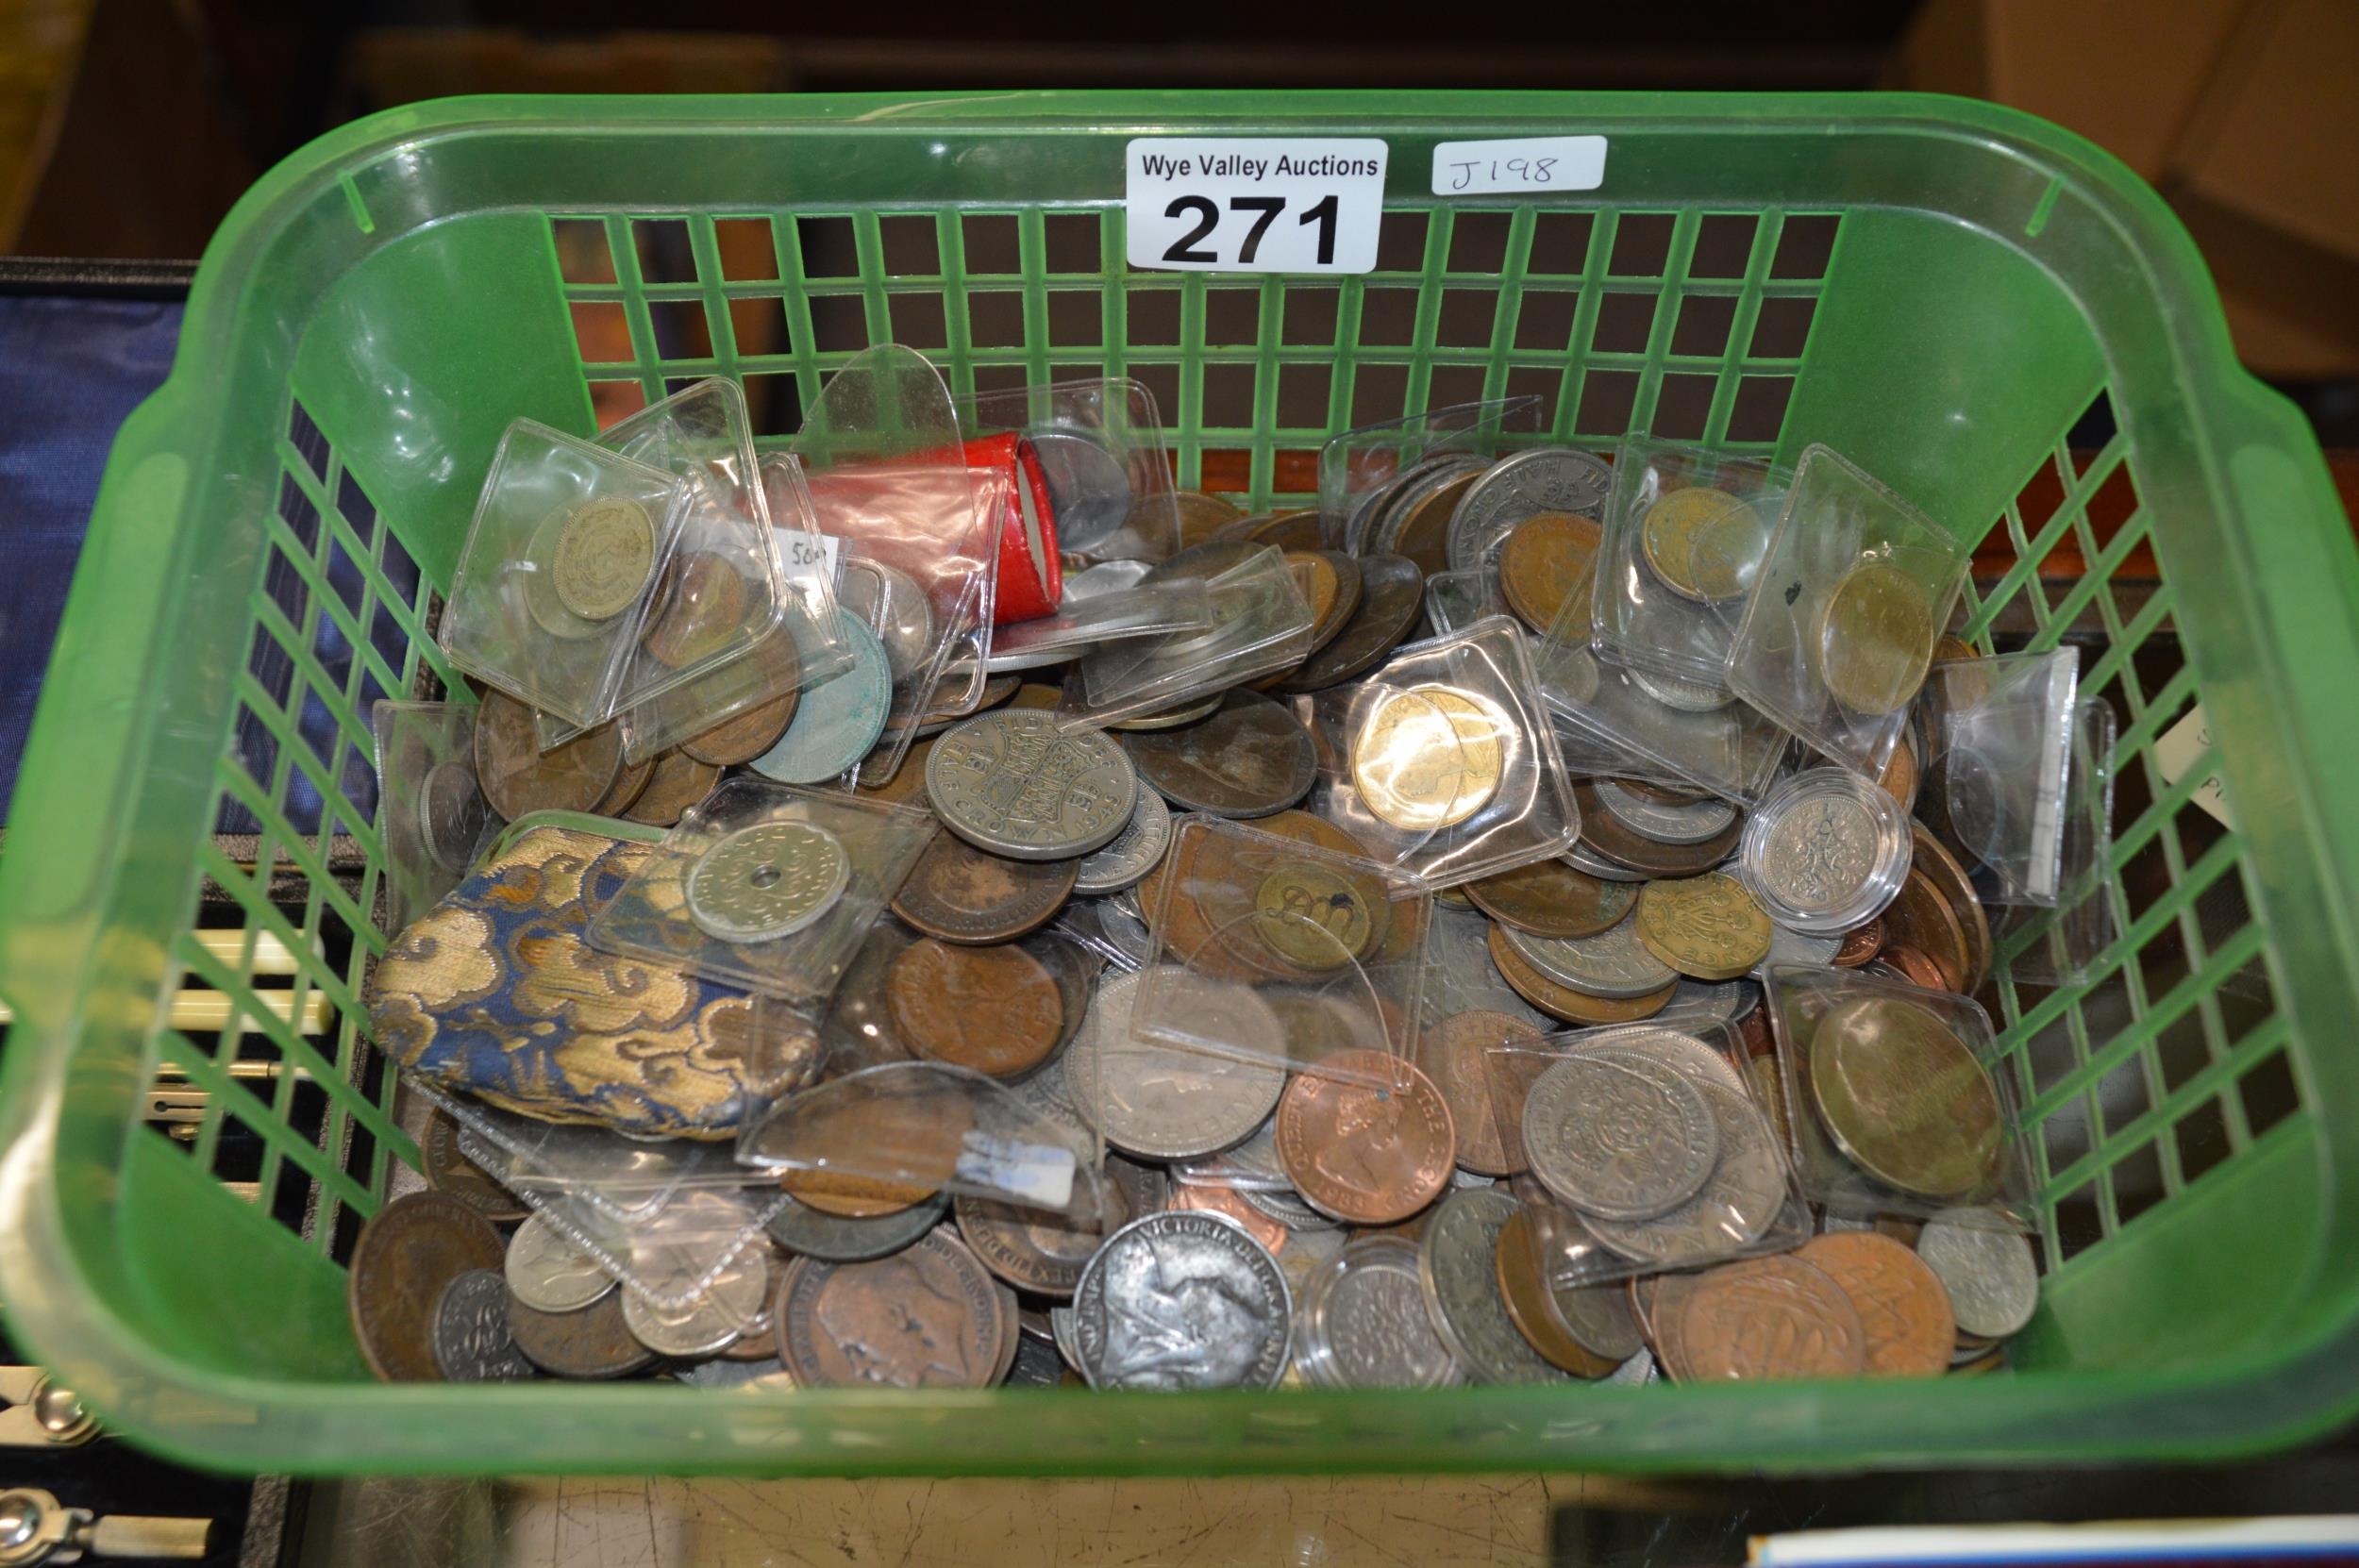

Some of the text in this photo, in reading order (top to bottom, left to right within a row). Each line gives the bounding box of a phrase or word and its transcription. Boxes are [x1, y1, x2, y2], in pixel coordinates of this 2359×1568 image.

[1143, 155, 1379, 180] Wye Valley Auctions
[1449, 158, 1560, 190] J198
[1162, 194, 1339, 265] 271
[937, 740, 970, 792] HALF
[953, 798, 1069, 841] CROWN
[1074, 792, 1122, 832] 1945
[1079, 863, 1124, 880] ONE
[1681, 931, 1768, 967] PENCE
[1416, 1088, 1447, 1134] THE
[1284, 1097, 1312, 1172] QUEEN
[1138, 1215, 1232, 1247] VICTORIA
